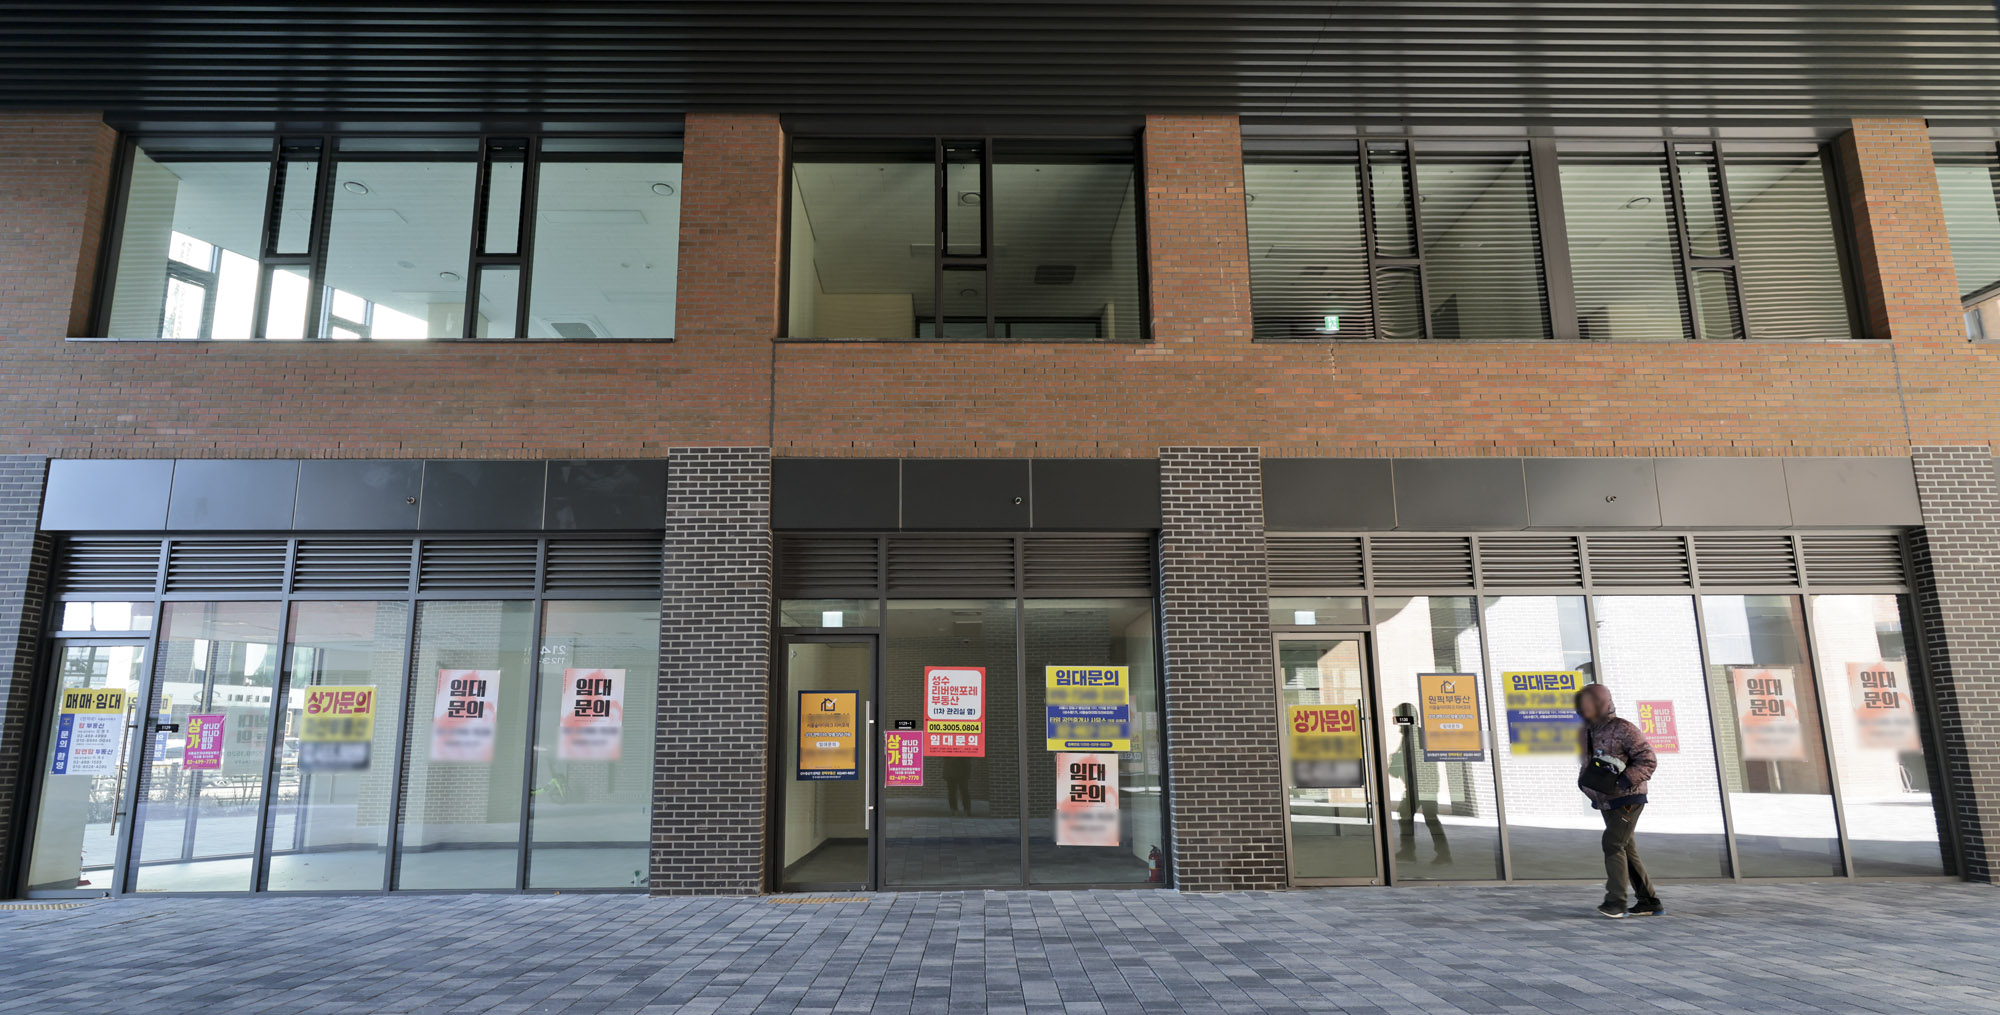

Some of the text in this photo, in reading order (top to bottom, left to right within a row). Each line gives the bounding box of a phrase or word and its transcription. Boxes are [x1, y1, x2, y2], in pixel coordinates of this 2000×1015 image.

[932, 675, 950, 686] 성수
[1056, 670, 1119, 686] 임대문의
[1511, 674, 1576, 691] 임대문의
[1746, 678, 1783, 696] 임대
[1860, 671, 1896, 688] 임대
[450, 679, 487, 698] 임대
[575, 678, 612, 697] 임대
[931, 686, 978, 696] 리버앤포레
[65, 693, 122, 709] 매매·임대
[307, 691, 372, 714] 상가문의
[573, 699, 611, 718] 문의
[931, 696, 960, 706] 부동산
[1428, 695, 1471, 704] 원픽부동산
[1750, 699, 1786, 717] 문의
[1864, 692, 1900, 709] 문의
[447, 700, 485, 719] 문의
[933, 707, 945, 715] (1차
[946, 708, 966, 716] 관리실
[929, 724, 980, 732] 010.3005.0804
[1293, 709, 1356, 733] 상가문의
[1639, 704, 1655, 734] 상가
[58, 730, 69, 748] 문의
[186, 718, 203, 749] 상가
[887, 734, 901, 765] 상가
[56, 752, 66, 770] 환영
[1069, 763, 1106, 781] 임대
[1069, 784, 1106, 803] 문의
